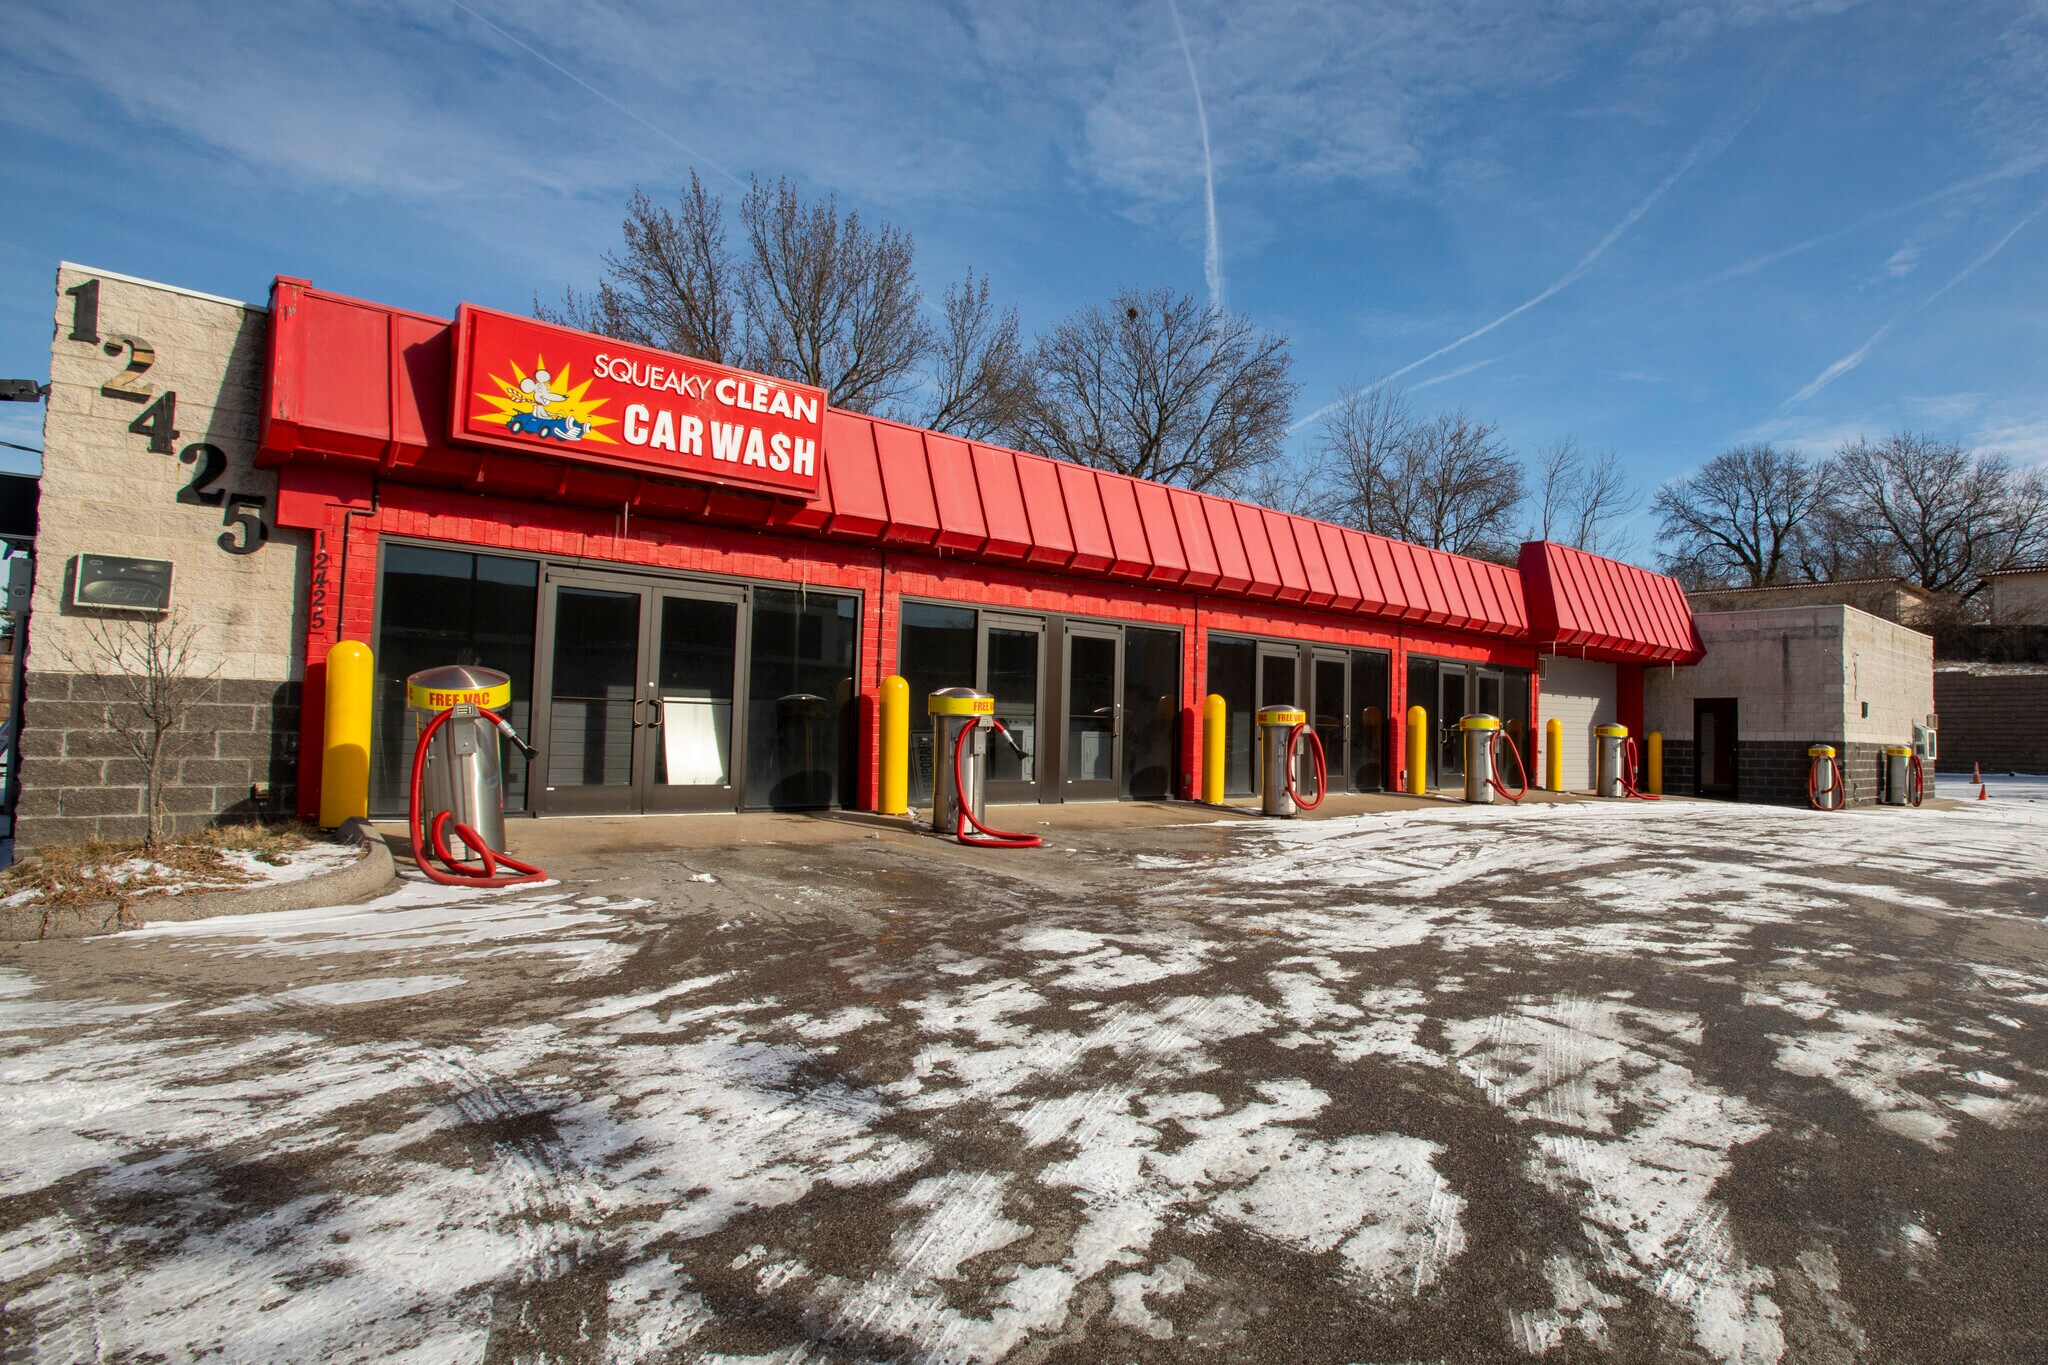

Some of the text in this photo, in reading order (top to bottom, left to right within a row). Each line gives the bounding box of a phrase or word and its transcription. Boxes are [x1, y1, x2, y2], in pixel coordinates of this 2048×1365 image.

[593, 353, 818, 424] SQUEAKY CLEAN
[623, 403, 816, 477] CAR WASH
[311, 532, 329, 629] 12425
[429, 692, 459, 706] FREE
[463, 692, 490, 705] VAC
[973, 701, 989, 712] FREE
[1278, 713, 1293, 722] FREE
